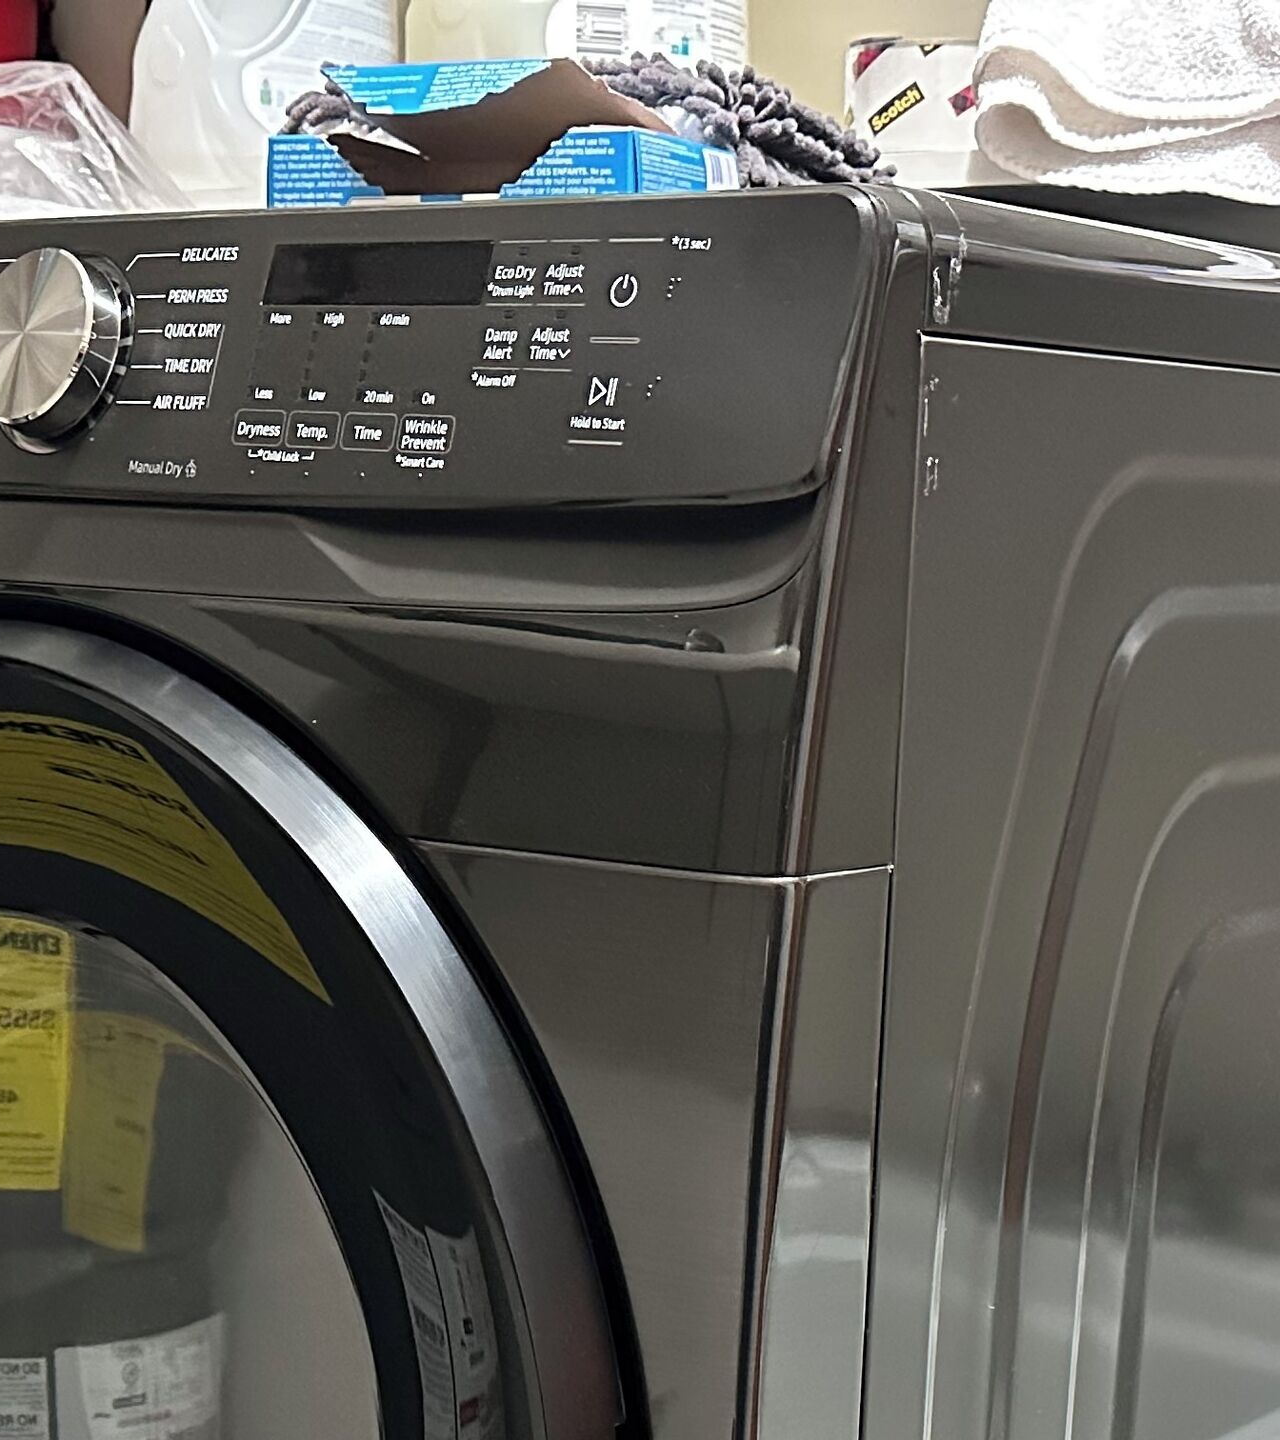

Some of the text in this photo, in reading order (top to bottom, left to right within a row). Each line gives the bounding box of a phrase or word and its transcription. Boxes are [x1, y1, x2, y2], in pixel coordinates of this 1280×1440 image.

[871, 87, 922, 132] Scotch
[181, 247, 239, 261] DELICATES
[545, 264, 585, 280] Adjust
[168, 288, 230, 303] PERM PRESS
[514, 284, 535, 299] Light
[543, 281, 570, 296] Time
[270, 313, 292, 325] More
[323, 312, 345, 328] High
[379, 313, 410, 326] 60 min
[164, 323, 222, 338] QUICK DRY
[485, 328, 518, 345] Damp
[531, 328, 570, 343] Adjust
[483, 345, 513, 360] Alert
[529, 346, 557, 360] Time
[165, 358, 214, 373] TIME DRY
[501, 373, 516, 387] Off
[254, 387, 274, 399] Less
[307, 388, 326, 401] Low
[363, 390, 394, 403] 20 min
[421, 391, 435, 404] On
[153, 395, 207, 410] AIR FLUFF
[236, 420, 281, 439] Dryness
[404, 419, 448, 435] Wrinkle
[570, 416, 626, 431] Hold to Start
[295, 423, 329, 442] Temp.
[353, 425, 382, 441] Time
[400, 434, 447, 451] Prevent
[281, 450, 300, 462] Lock
[425, 454, 445, 469] Care
[128, 460, 183, 478] Manual Dry
